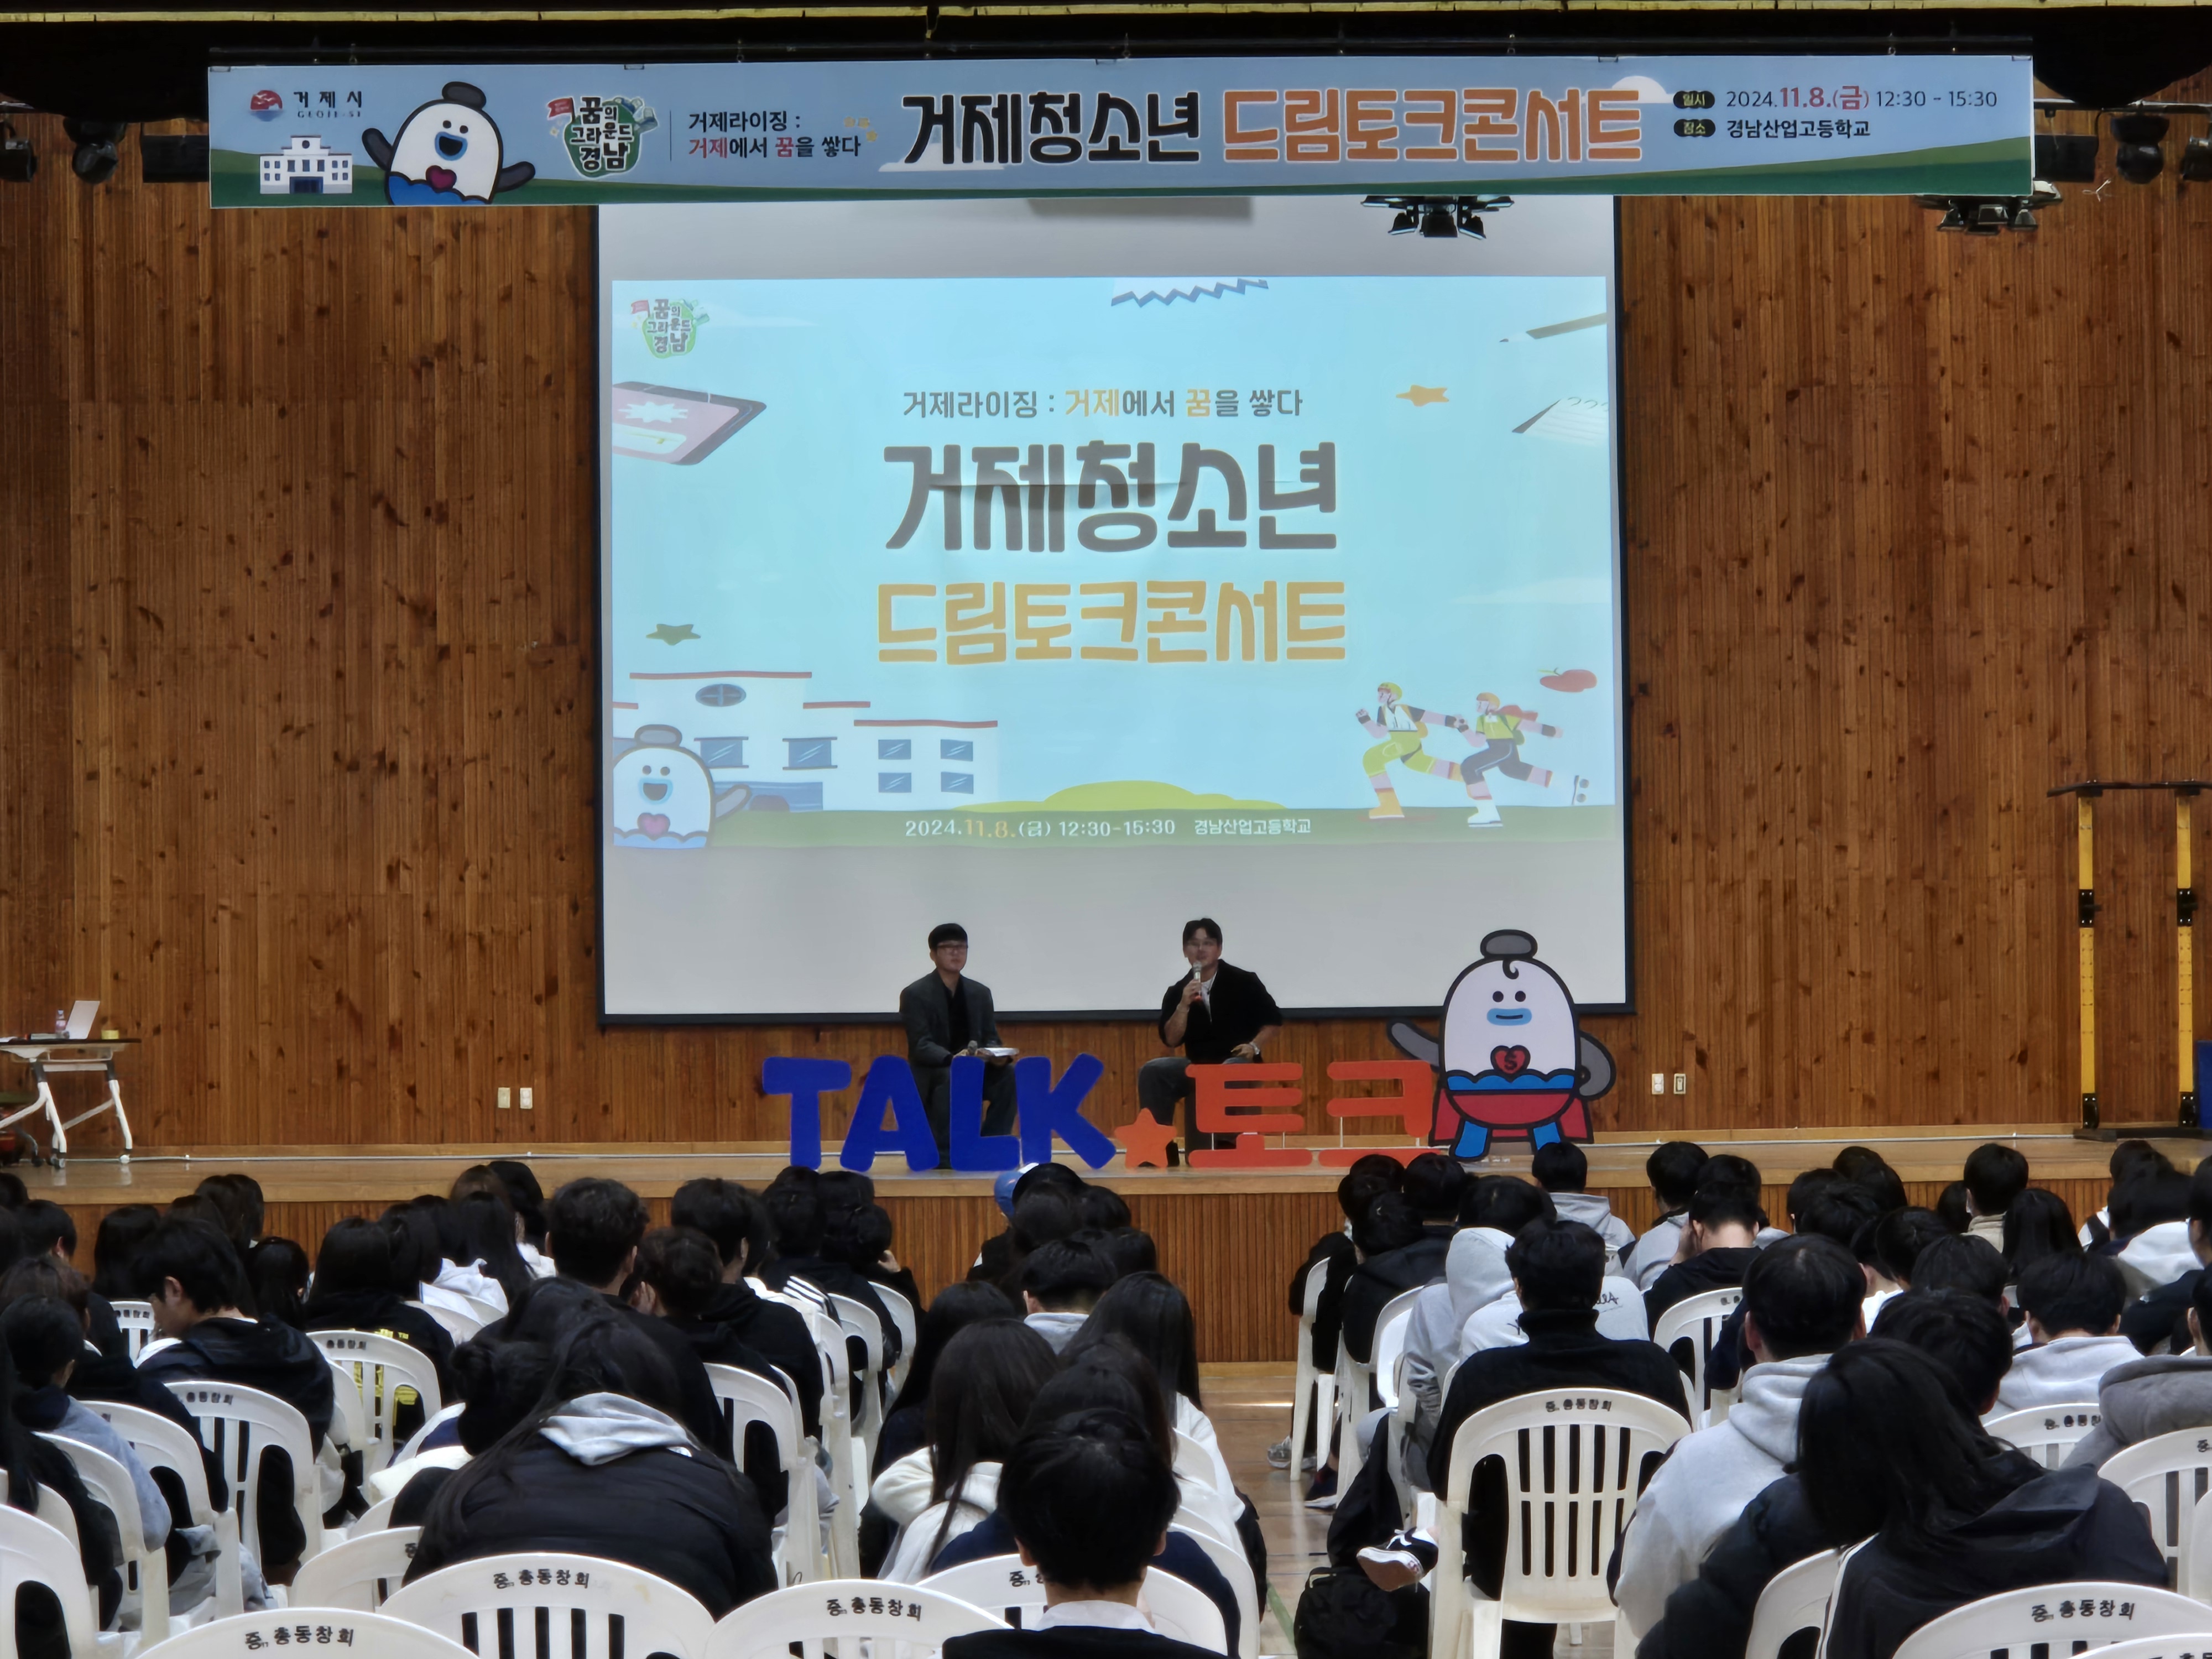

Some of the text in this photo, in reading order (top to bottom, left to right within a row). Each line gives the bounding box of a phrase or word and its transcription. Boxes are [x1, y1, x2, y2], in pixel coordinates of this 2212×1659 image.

[1726, 86, 1869, 110] 2024.11.8.(금)
[1877, 91, 1926, 107] 12:30
[1949, 91, 1997, 107] 15:30
[571, 122, 633, 144] 그라운드
[688, 111, 787, 132] 거제라이징
[902, 91, 1199, 164] 거제청소년
[1224, 88, 1641, 161] 드림토크콘서트
[1727, 119, 1871, 138] 경남산업고등학교
[581, 142, 629, 170] 경남
[688, 135, 861, 159] 거제에서 꿈을 쌓다
[904, 391, 1037, 418] 거제라이징
[1065, 389, 1174, 417] 거제에서
[1186, 389, 1239, 417] 꿈을
[1249, 389, 1303, 417] 쌓다
[883, 440, 1337, 552] 거제청소년
[878, 580, 1346, 665] 드림토크콘서트
[1058, 820, 1176, 837] 12:30-15:30
[1194, 819, 1311, 835] 경남산업고등학교
[763, 1053, 1116, 1171] TALK
[1185, 1060, 1442, 1168] 토크
